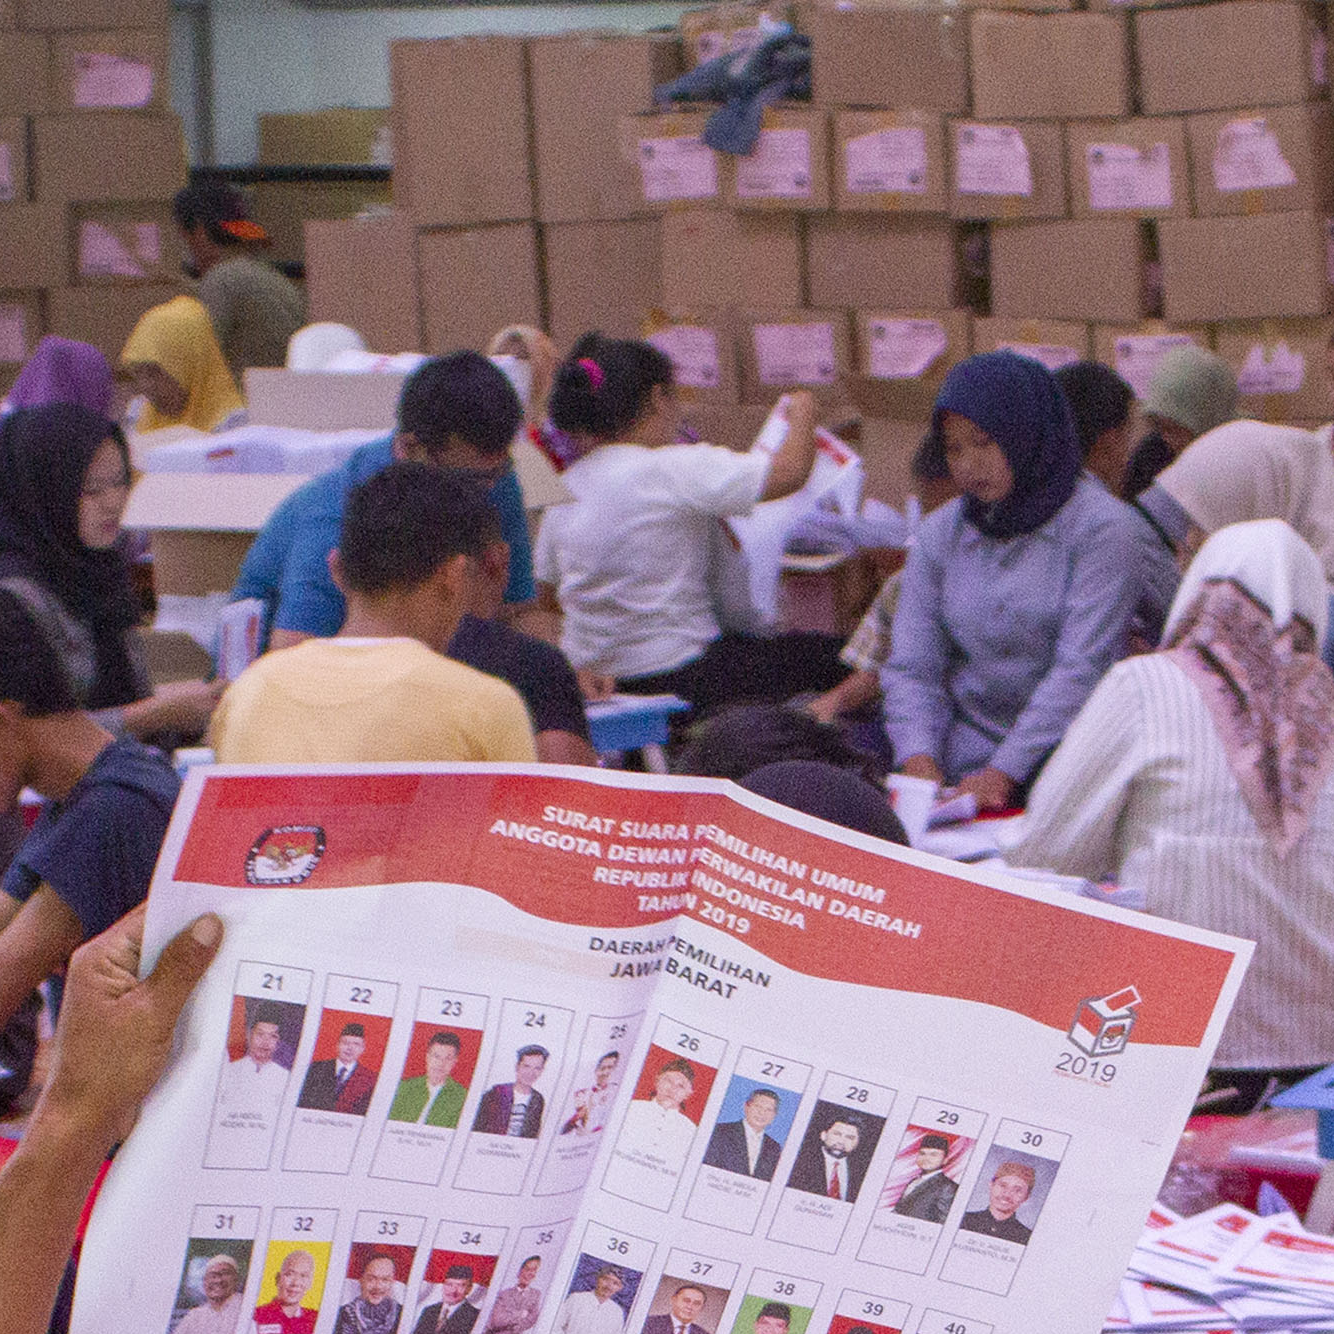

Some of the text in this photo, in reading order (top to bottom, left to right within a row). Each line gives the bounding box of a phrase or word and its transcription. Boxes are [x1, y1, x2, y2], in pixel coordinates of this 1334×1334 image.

[541, 805, 887, 904] SURAT SUARA PEMILIHAN UMUM
[489, 819, 923, 939] ANGGOTA DEWAN PERWAKILAN DAERAH
[593, 866, 806, 930] REPUBLIK INDONESIA
[637, 894, 751, 934] TAHUN 2019
[589, 935, 771, 988] DAERAH PEMILIHAN
[261, 973, 284, 992] 21
[609, 956, 738, 1000] JAWA BARAT
[349, 987, 373, 1005] 22
[441, 1000, 463, 1017] 23
[524, 1012, 547, 1029] 24
[677, 1033, 701, 1053] 26
[761, 1062, 786, 1079] 27
[1056, 1052, 1116, 1082] 2019
[845, 1086, 870, 1103] 28
[935, 1110, 960, 1127] 29
[1020, 1131, 1044, 1149] 30
[214, 1214, 234, 1230] 31
[292, 1216, 313, 1232] 32
[376, 1220, 399, 1236] 33
[460, 1231, 481, 1246] 34
[607, 1237, 631, 1256] 36
[690, 1261, 714, 1277] 37
[773, 1280, 796, 1297] 38
[861, 1300, 885, 1318] 39
